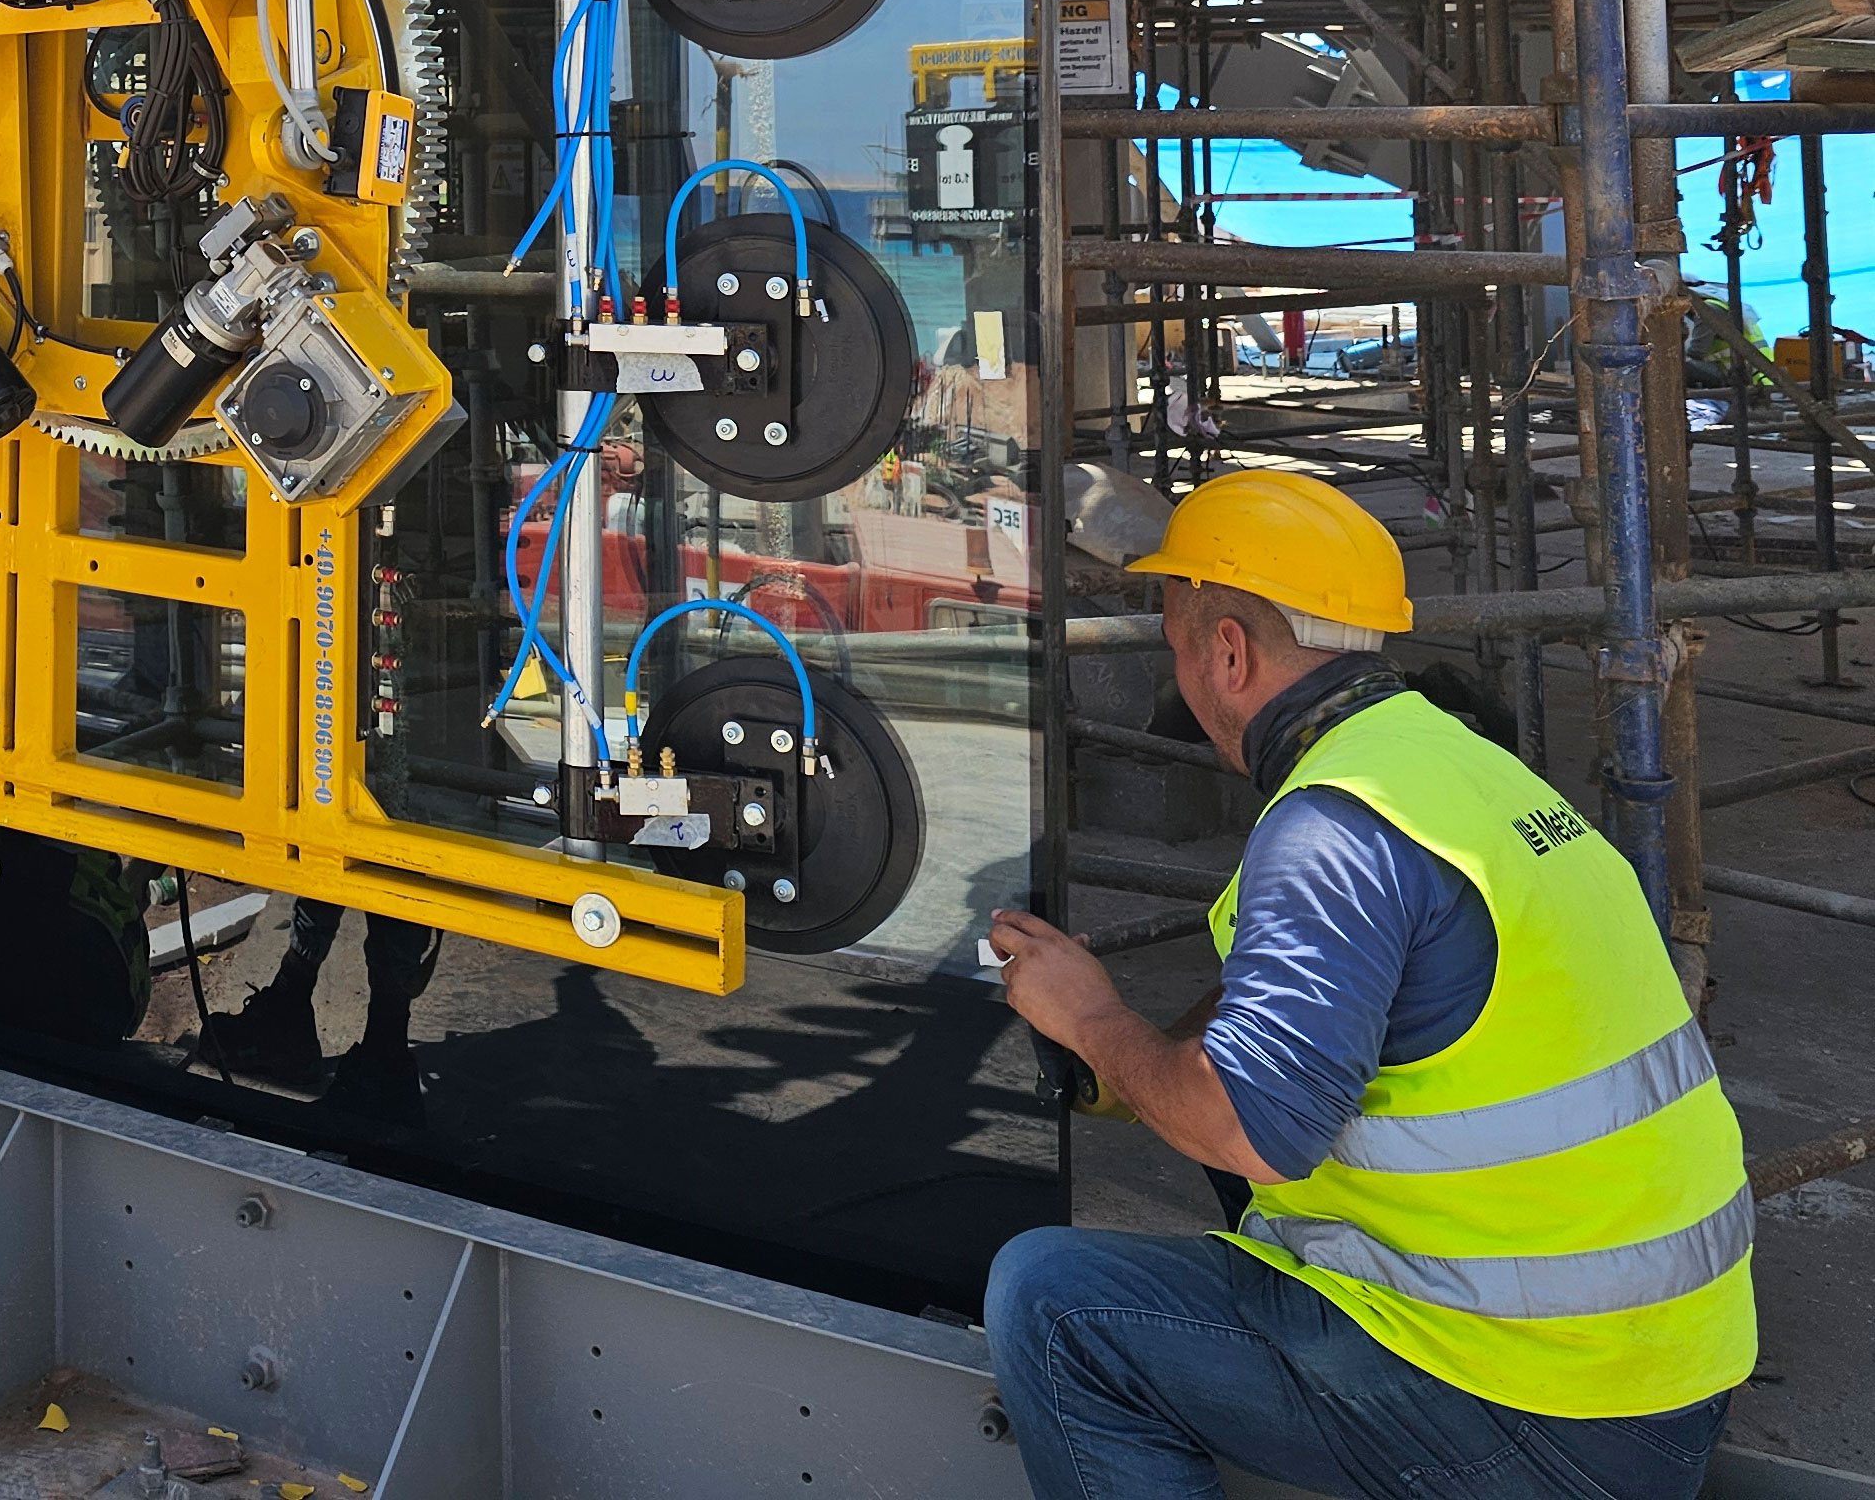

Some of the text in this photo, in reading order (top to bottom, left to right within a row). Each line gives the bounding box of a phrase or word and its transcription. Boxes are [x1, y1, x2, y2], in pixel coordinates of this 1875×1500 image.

[566, 249, 576, 267] 3
[650, 368, 675, 382] 3
[314, 528, 335, 805] +49.9070-9689690-0
[1528, 801, 1587, 848] Metal
